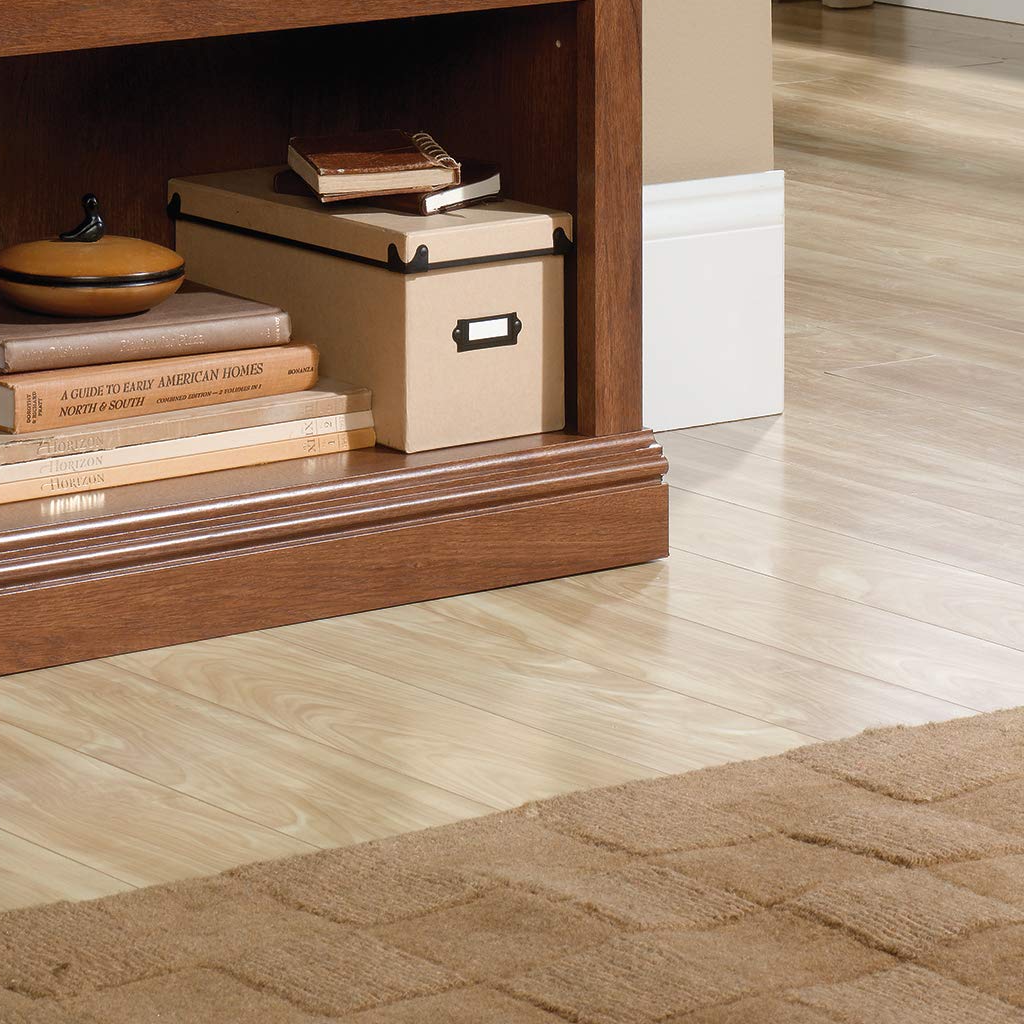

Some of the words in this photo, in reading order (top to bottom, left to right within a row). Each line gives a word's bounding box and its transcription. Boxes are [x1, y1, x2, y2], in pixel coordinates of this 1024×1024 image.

[287, 366, 314, 376] BONANZA
[60, 390, 68, 400] A
[70, 385, 104, 400] GUIDE
[106, 383, 121, 395] TO
[123, 379, 155, 393] EARLY
[157, 368, 220, 388] AMERICAN
[222, 362, 264, 379] HOMES
[156, 395, 188, 404] COMBINED
[188, 391, 212, 400] EDITION
[59, 402, 98, 417] NORTH
[99, 402, 108, 412] &
[109, 396, 145, 411] SOUTH
[40, 456, 103, 474] HORIZON
[41, 474, 105, 491] HORIZON
